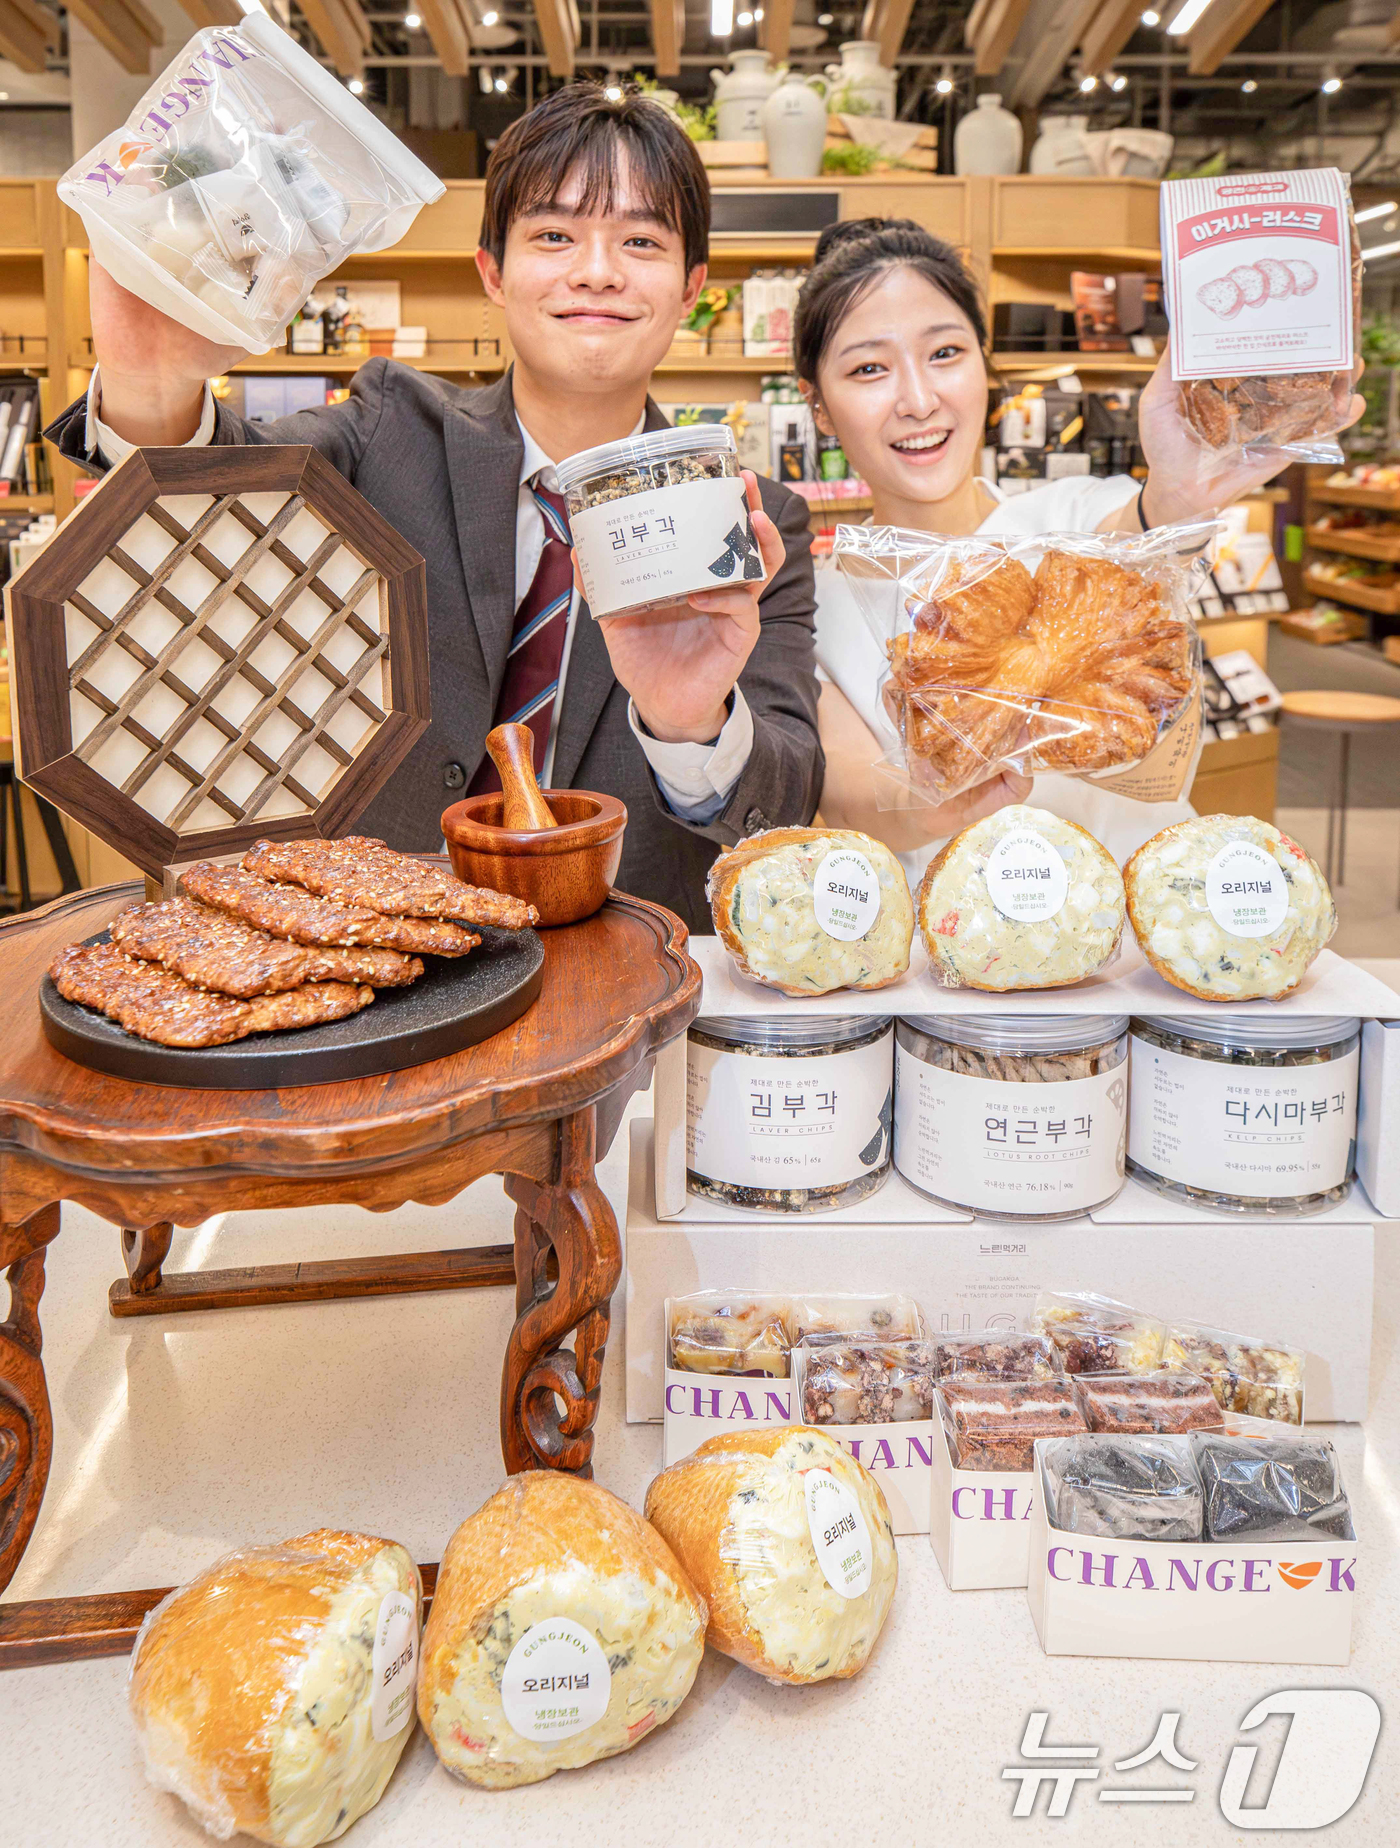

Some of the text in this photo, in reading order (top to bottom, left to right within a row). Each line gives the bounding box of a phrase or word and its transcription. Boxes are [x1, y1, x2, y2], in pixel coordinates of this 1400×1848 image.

[1190, 210, 1323, 242] 이거시-러스크
[606, 508, 655, 526] 제대로 만든 순박한
[608, 516, 675, 550] 김부각
[617, 543, 676, 562] LAVER CHIPS
[1000, 838, 1048, 856] GUNGJEON
[830, 856, 870, 876] GUNGJEON
[1219, 850, 1268, 868] GUNGJEON
[1001, 867, 1051, 880] 오리지널
[827, 882, 868, 903] 오리지널
[1221, 881, 1272, 894] 오리지널
[1012, 893, 1045, 901] 냉장보관
[832, 908, 858, 922] 냉장보관
[1233, 907, 1266, 916] 냉장보관
[751, 1079, 773, 1087] 제대로
[797, 1079, 818, 1088] 순박한
[1226, 1086, 1250, 1095] 제대로
[1275, 1088, 1297, 1096] 순박한
[750, 1090, 838, 1118] 김부각
[985, 1103, 1009, 1112] 제대로
[1013, 1105, 1028, 1113] 만든
[1226, 1091, 1345, 1127] 다시마부각
[799, 1125, 832, 1133] CHIPS
[985, 1114, 1092, 1144] 연근부각
[750, 1155, 771, 1164] 국내산
[1063, 1149, 1089, 1158] CHIPS
[1224, 1162, 1247, 1171] 국내산
[1276, 1164, 1305, 1173] 69.95%
[984, 1180, 1005, 1190] 국내산
[1026, 1183, 1055, 1191] 76.18%
[980, 1244, 1026, 1253] 느린먹거리
[666, 1384, 790, 1420] CHAN
[811, 1480, 840, 1512] GUNGJEON
[824, 1512, 856, 1547] 오리지널
[523, 1632, 589, 1657] GUNGJEON
[383, 1640, 413, 1687] 오리지널
[522, 1673, 589, 1692] 오리지널
[535, 1707, 579, 1720] 냉장보관
